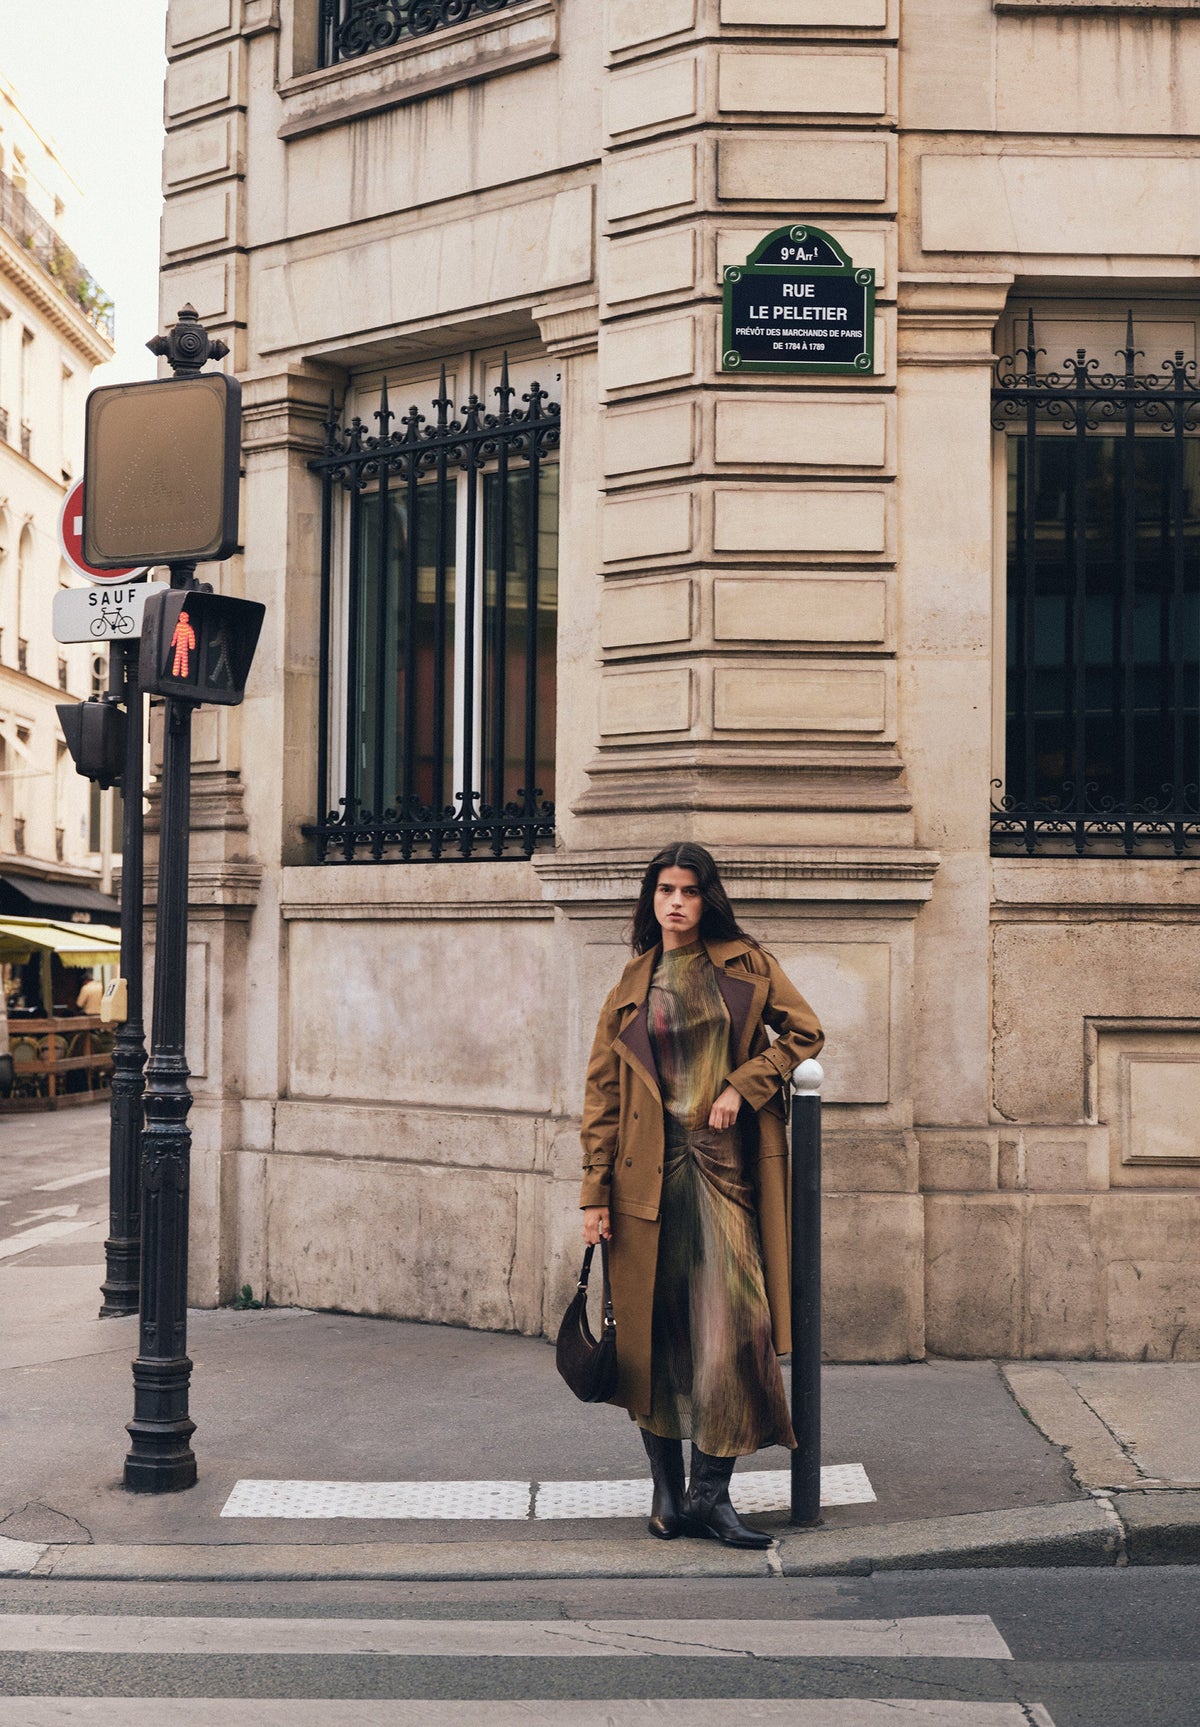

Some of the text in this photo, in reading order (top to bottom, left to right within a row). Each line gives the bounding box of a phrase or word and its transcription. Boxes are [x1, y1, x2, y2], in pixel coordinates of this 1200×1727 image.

[782, 283, 815, 298] RUE
[749, 305, 848, 321] LE PELETIER
[735, 326, 863, 338] PRÉVÔT DES MARCHANDS DE PARIS
[773, 342, 784, 350] DE
[785, 342, 801, 350] 1784
[809, 343, 825, 351] 1789
[89, 589, 136, 606] SAUF
